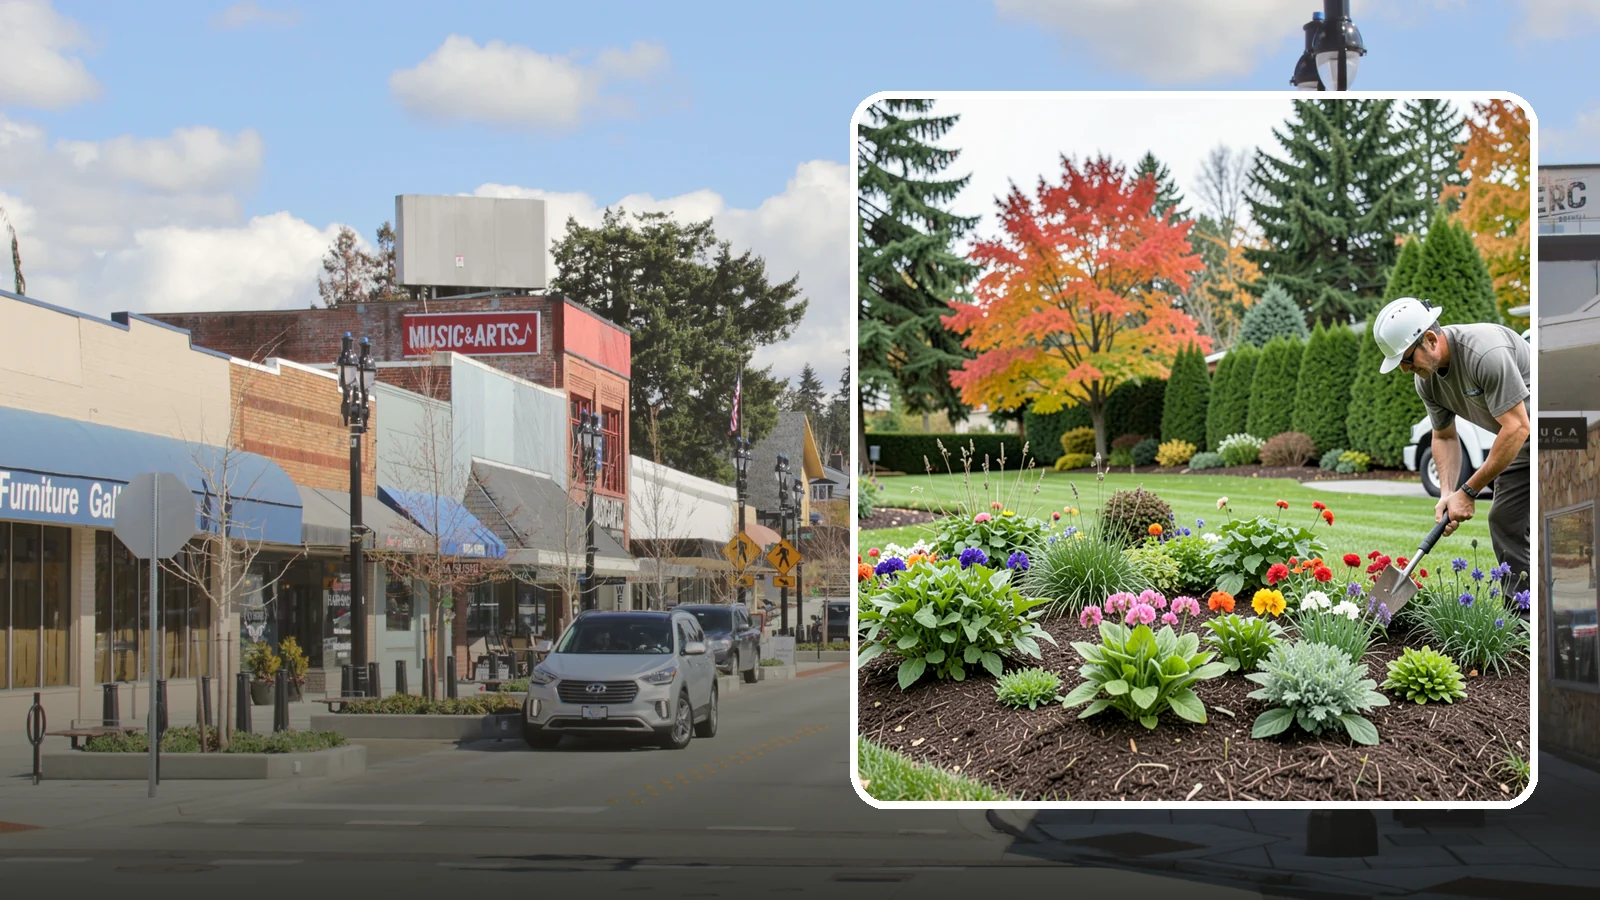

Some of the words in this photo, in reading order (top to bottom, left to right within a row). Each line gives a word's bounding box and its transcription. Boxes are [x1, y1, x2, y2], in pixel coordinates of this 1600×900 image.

[409, 323, 520, 349] MUSIC&ARTS
[0, 471, 79, 515] Furniture
[89, 482, 121, 519] Gal
